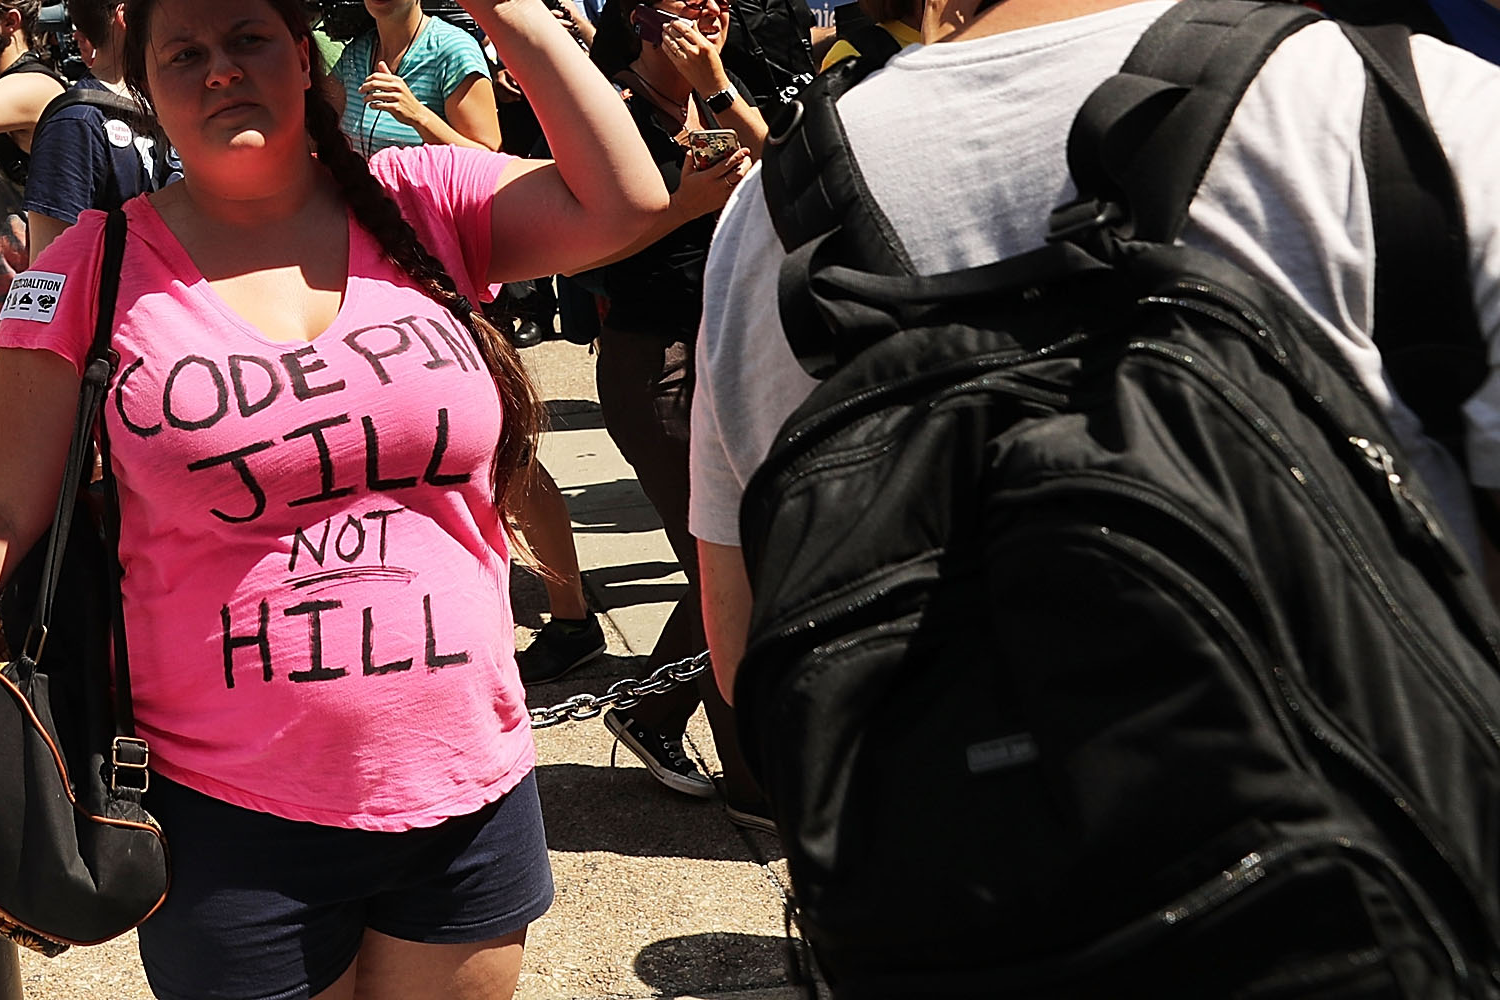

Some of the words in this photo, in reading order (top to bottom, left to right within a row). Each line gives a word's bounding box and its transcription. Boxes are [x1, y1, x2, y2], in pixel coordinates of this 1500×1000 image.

[114, 346, 346, 437] CODE
[342, 309, 480, 385] PIN
[187, 408, 472, 524] JILL
[287, 505, 411, 572] NOT
[219, 594, 474, 689] HILL
